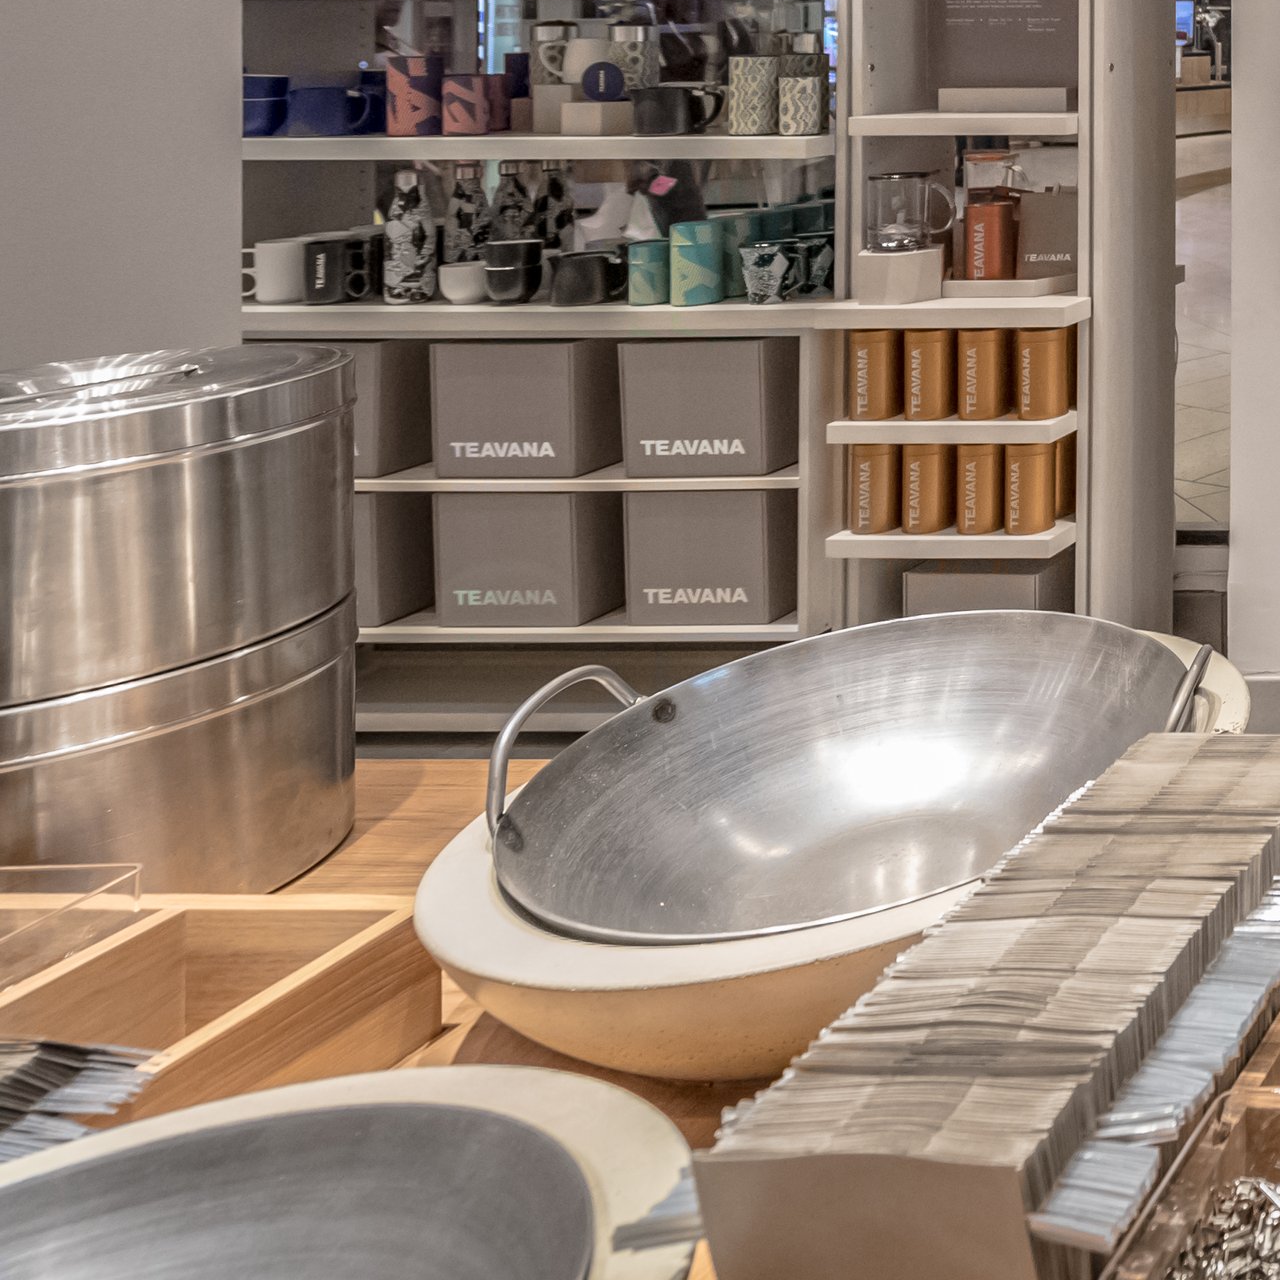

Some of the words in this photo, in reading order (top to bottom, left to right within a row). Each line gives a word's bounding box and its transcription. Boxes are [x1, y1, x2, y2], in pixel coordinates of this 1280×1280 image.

[974, 223, 985, 280] EAVANA
[1024, 253, 1071, 262] TEAVANA
[857, 348, 868, 415] TEAVANA
[911, 348, 921, 415] TEAVANA
[966, 348, 976, 414] TEAVANA
[1021, 348, 1031, 414] TEAVANA
[450, 442, 555, 458] TEAVANA
[640, 439, 746, 456] TEAVANA
[859, 461, 871, 528] TEAVANA
[909, 461, 920, 528] TEAVANA
[965, 461, 976, 528] TEAVANA
[1010, 462, 1020, 529] TEAVANA
[452, 590, 557, 607] TEAVANA
[643, 588, 748, 605] TEAVANA
